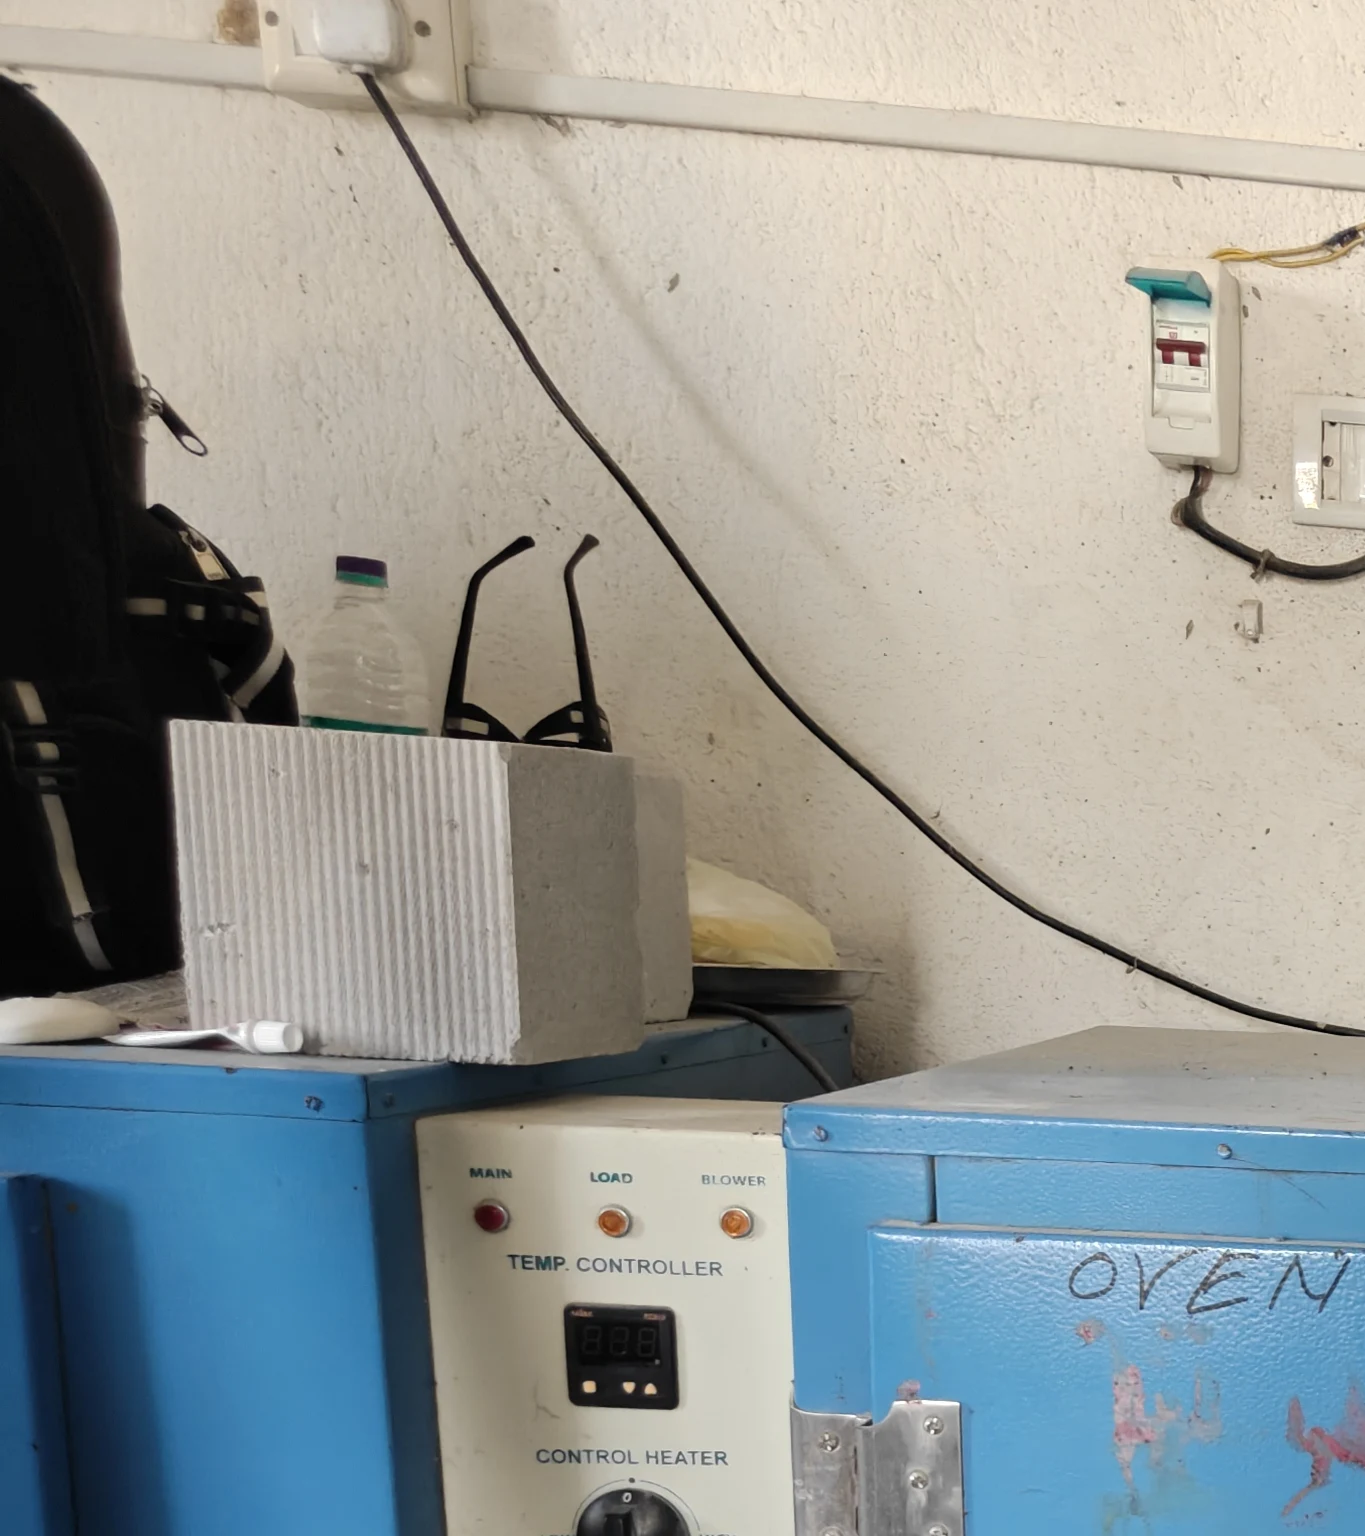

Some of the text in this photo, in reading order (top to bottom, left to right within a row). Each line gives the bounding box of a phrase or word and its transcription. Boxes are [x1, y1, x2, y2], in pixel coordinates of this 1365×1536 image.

[468, 1166, 512, 1179] MAIN
[590, 1171, 633, 1184] LOAD
[701, 1173, 766, 1187] BLOWER
[576, 1256, 723, 1277] CONTROLLER
[1068, 1248, 1351, 1315] OVEN
[536, 1448, 728, 1466] CONTROL HEATER
